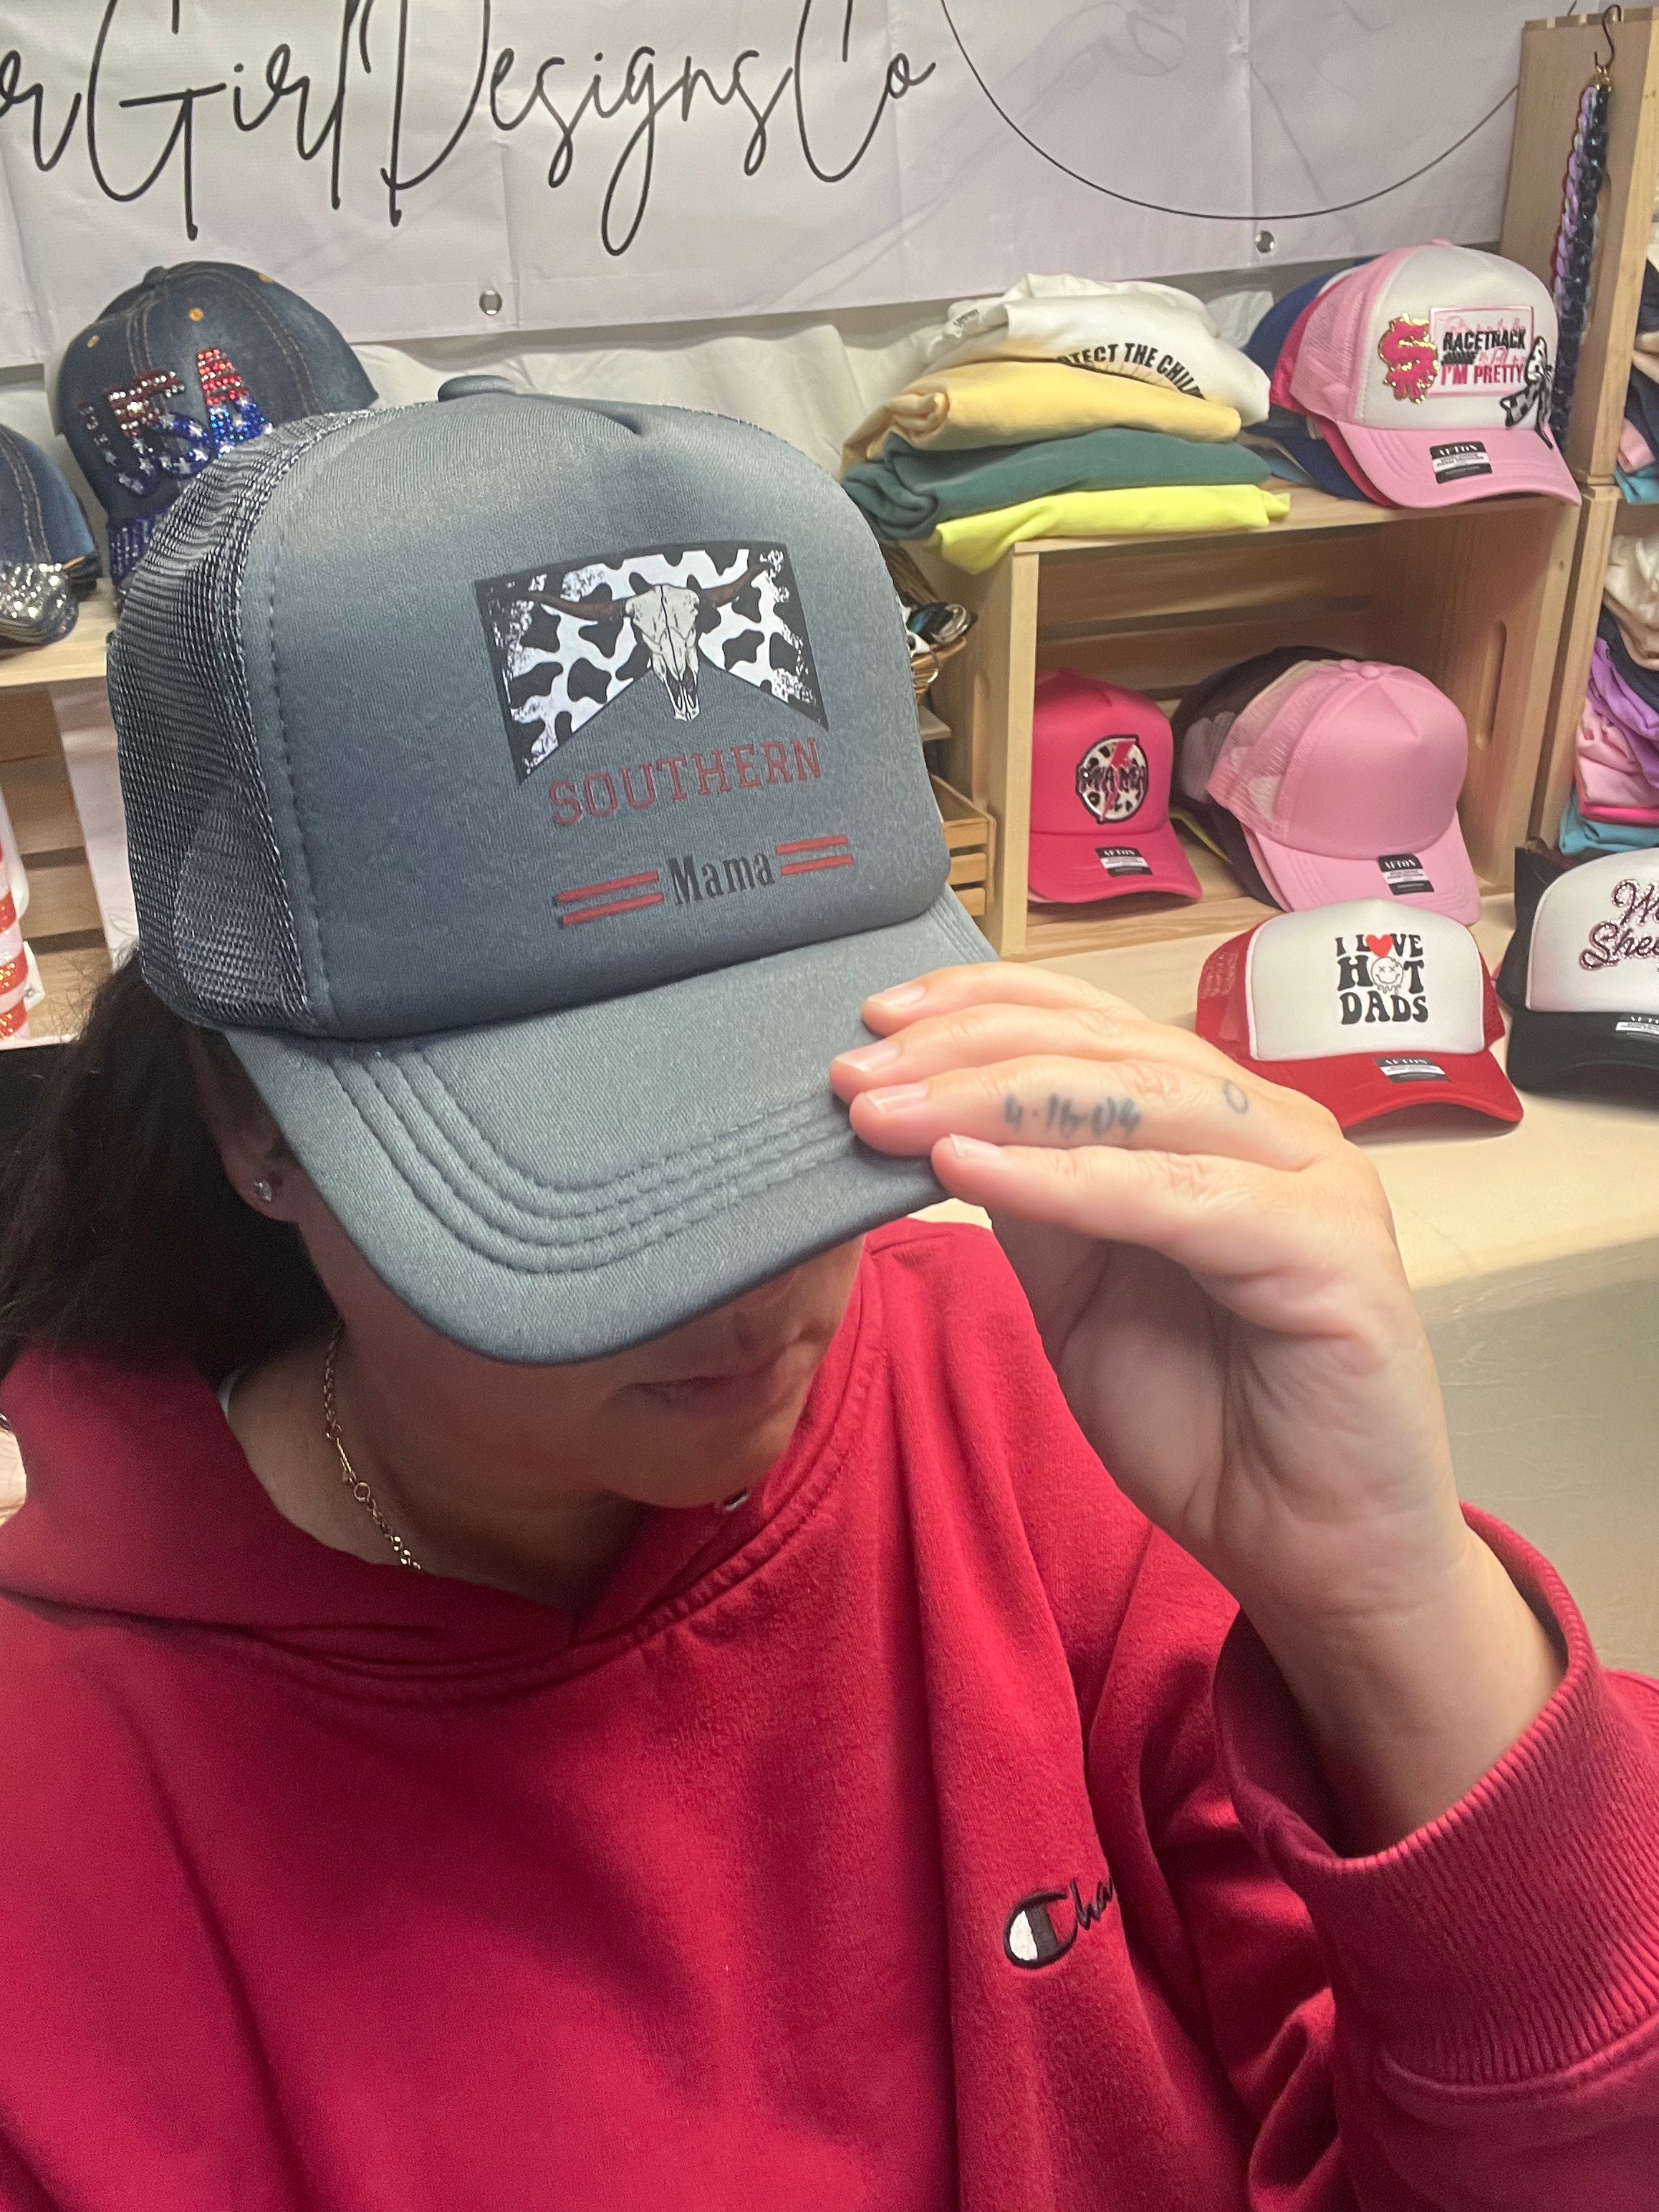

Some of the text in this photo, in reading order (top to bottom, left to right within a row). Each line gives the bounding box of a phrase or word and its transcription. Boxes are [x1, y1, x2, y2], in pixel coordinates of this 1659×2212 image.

[1443, 328, 1526, 352] RACETRACK
[1124, 342, 1159, 368] THE
[1441, 362, 1524, 385] I'M PRETTY
[549, 737, 822, 827] SOUTHERN
[666, 852, 776, 905] Mama
[1335, 937, 1347, 957] I
[1340, 990, 1428, 1025] DADS
